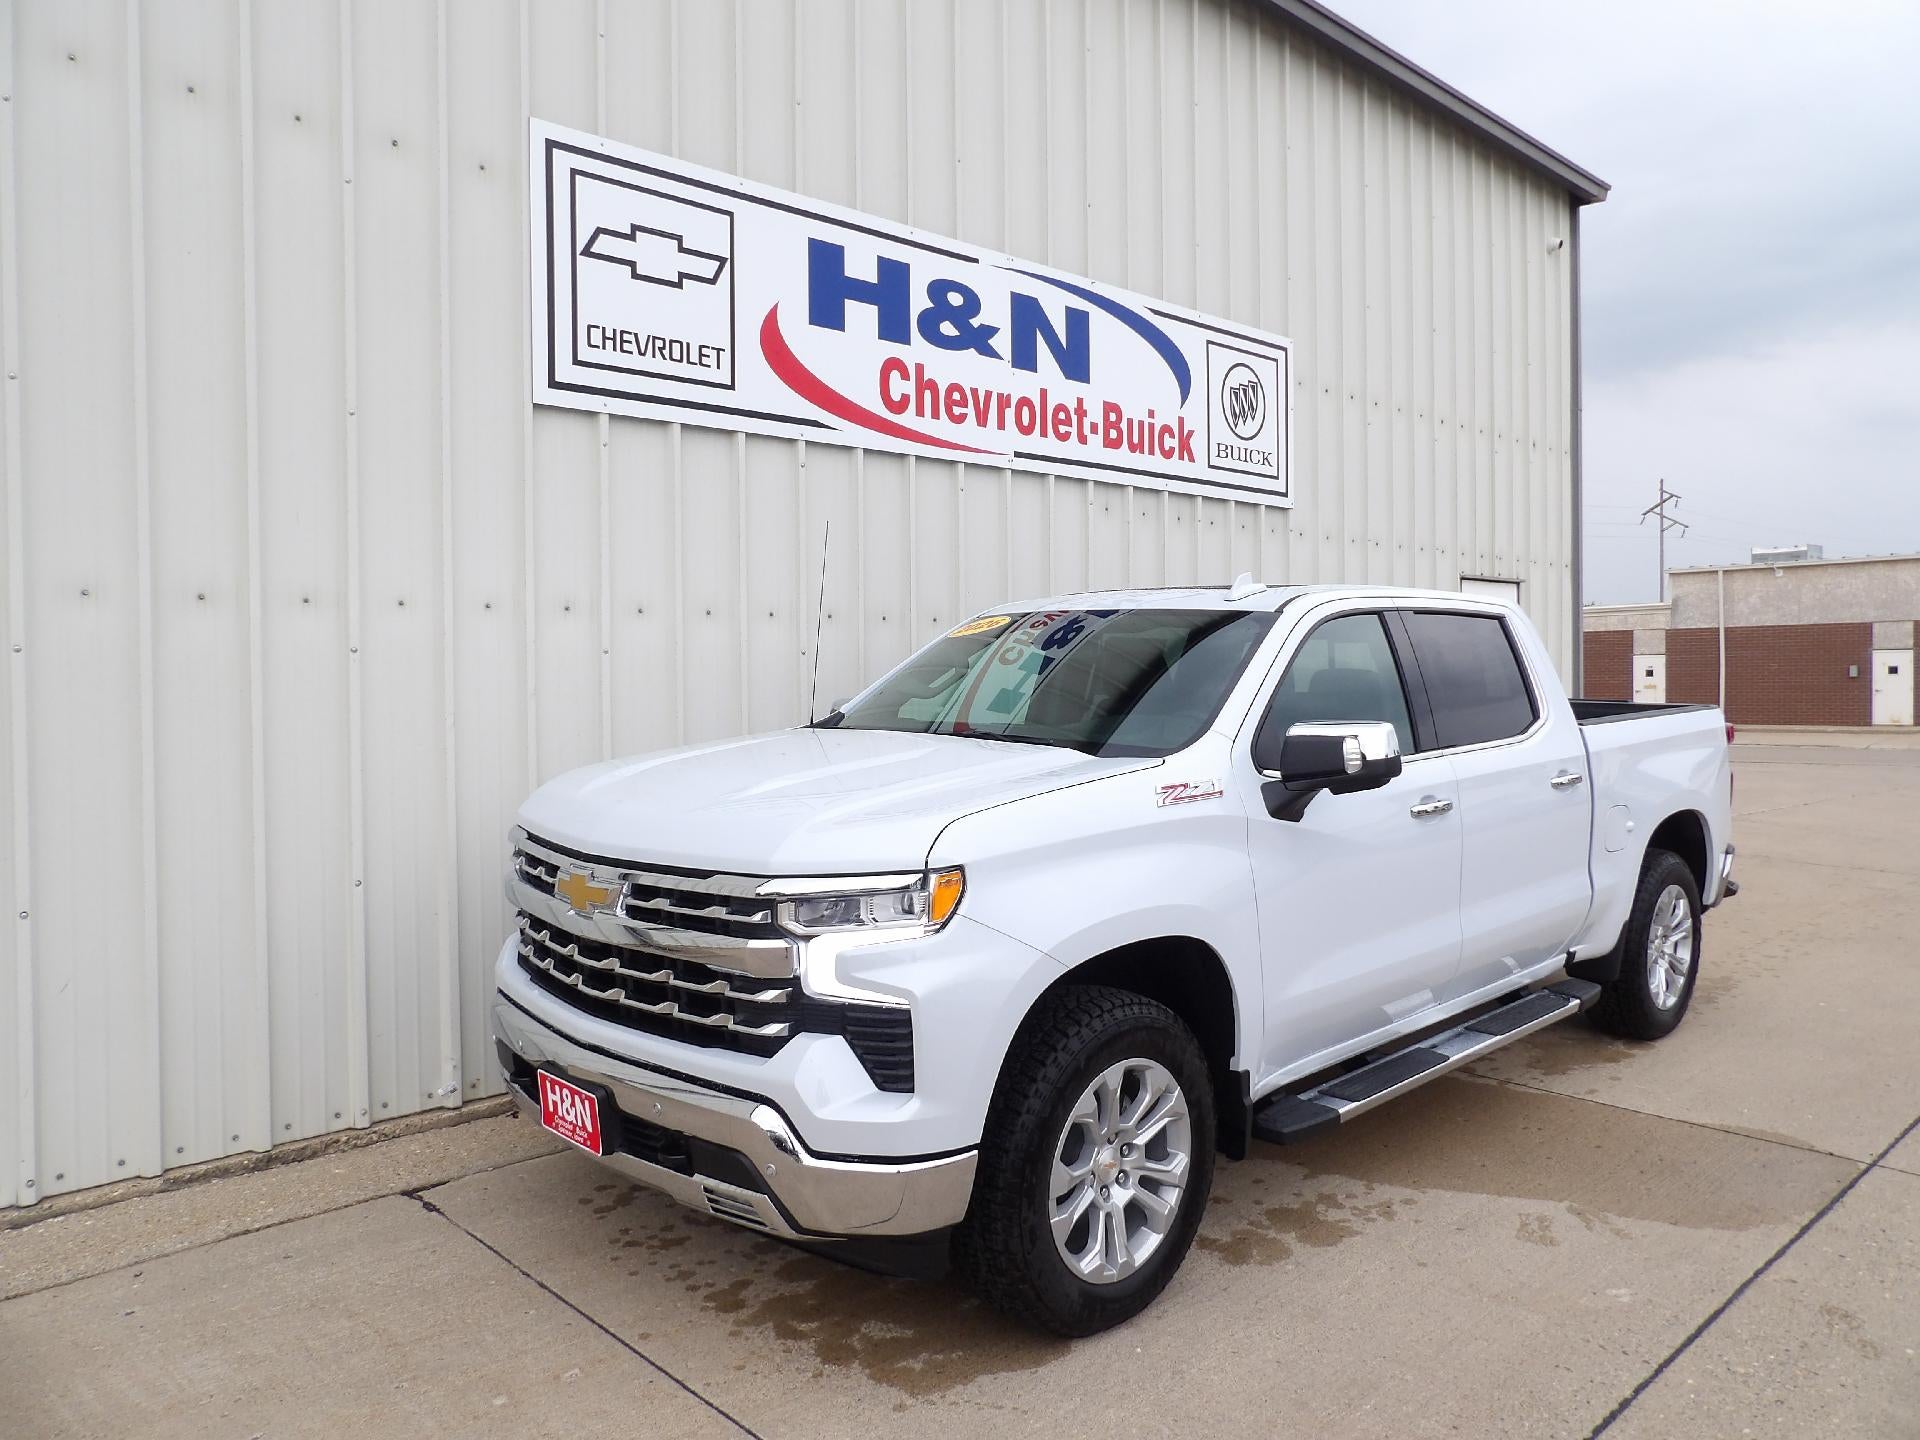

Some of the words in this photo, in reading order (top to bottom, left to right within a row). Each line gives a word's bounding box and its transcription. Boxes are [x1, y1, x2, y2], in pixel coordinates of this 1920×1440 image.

[808, 238, 1091, 383] H&N
[585, 323, 726, 371] CHEVROLET
[878, 355, 1196, 463] Chevrolet-Buick
[1214, 441, 1275, 469] BUICK
[545, 1079, 593, 1133] H&N
